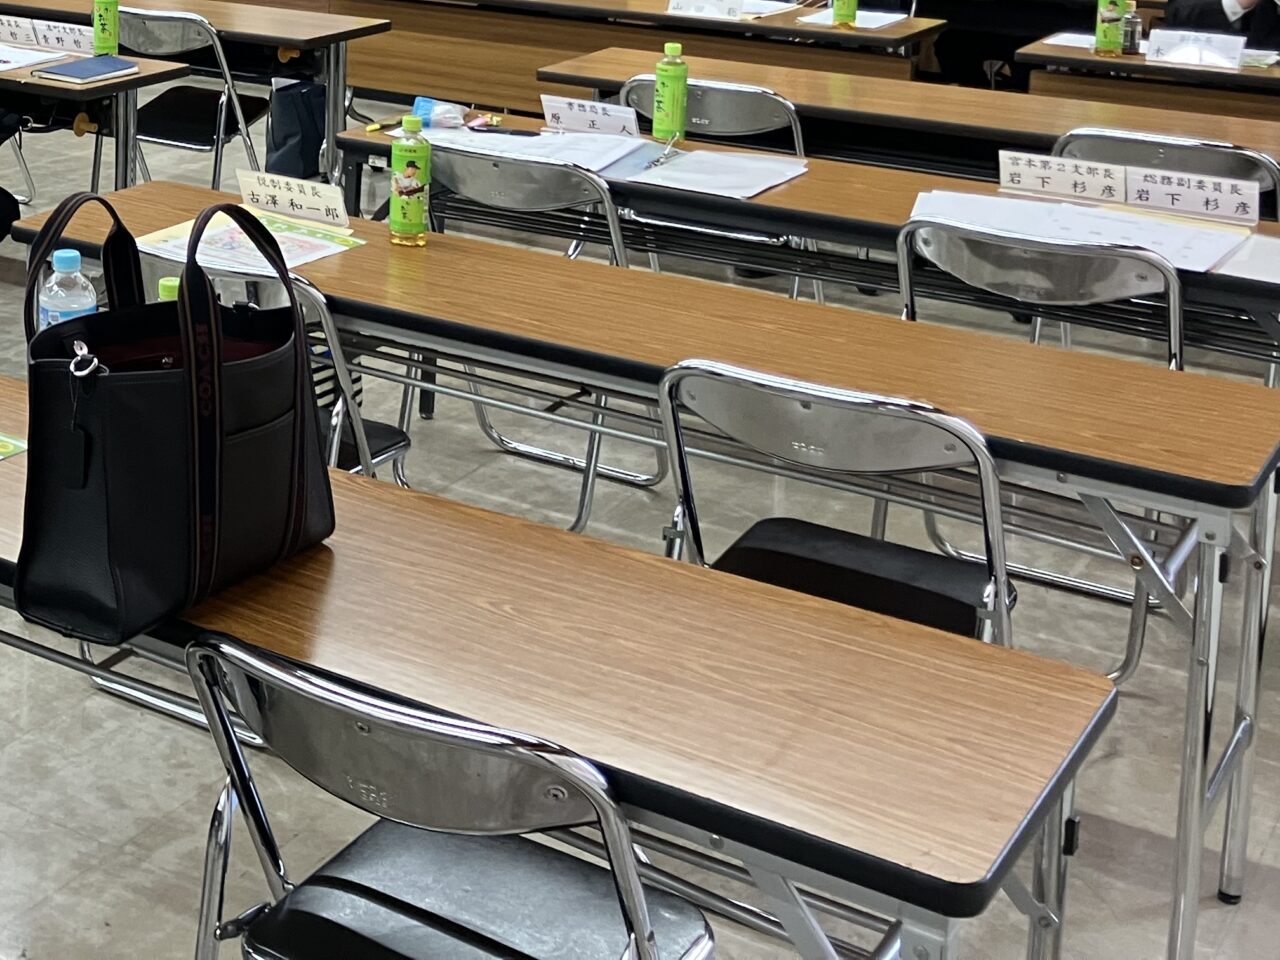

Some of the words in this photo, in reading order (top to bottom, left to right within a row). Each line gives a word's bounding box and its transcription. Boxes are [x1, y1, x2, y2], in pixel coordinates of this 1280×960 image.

[1007, 171, 1117, 200] 岩下杉彦
[1134, 187, 1252, 216] 岩下杉彦
